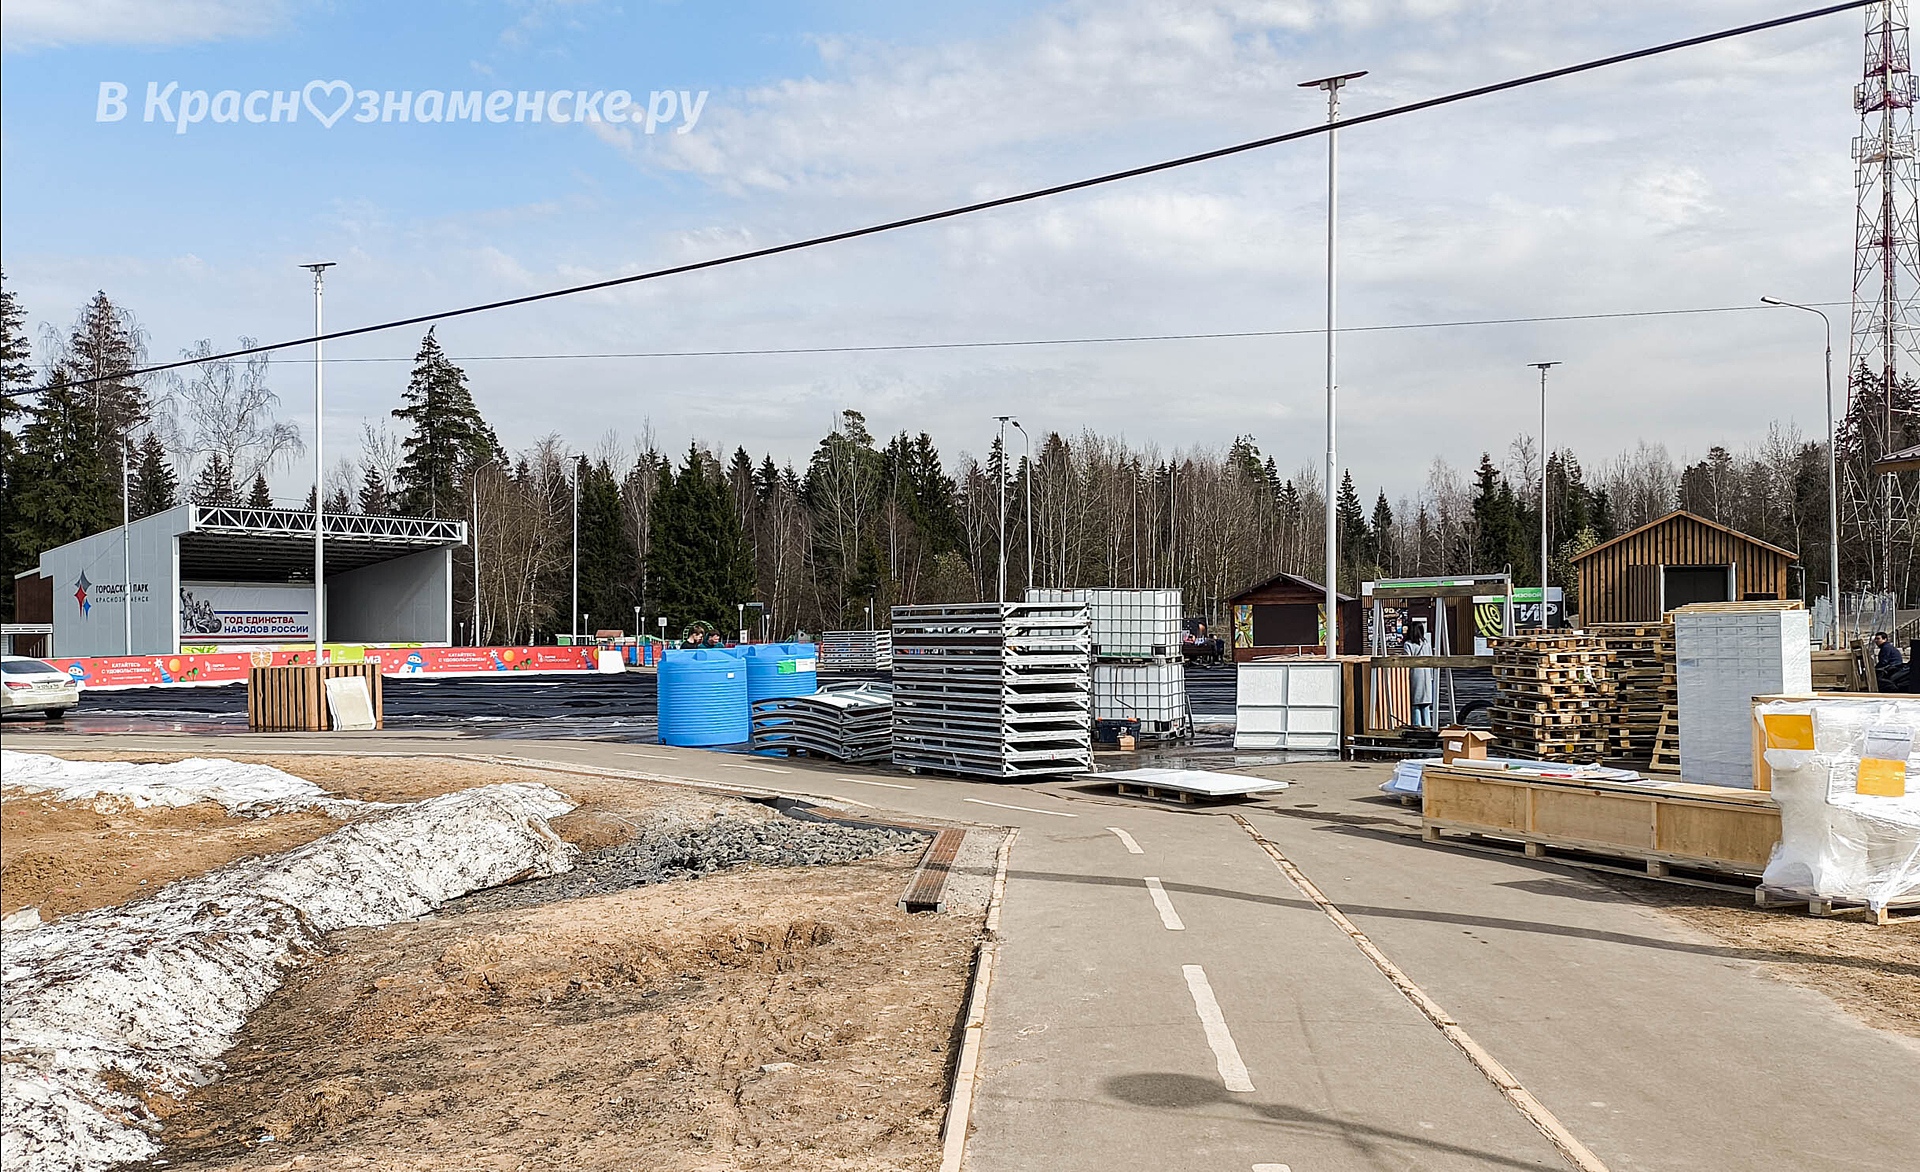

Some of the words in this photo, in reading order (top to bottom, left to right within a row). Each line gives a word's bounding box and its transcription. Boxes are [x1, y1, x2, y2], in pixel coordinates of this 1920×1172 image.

[133, 583, 149, 592] ПАРК
[224, 616, 243, 624] ГОД
[246, 616, 295, 624] ЕДИНСТВА
[224, 626, 269, 634] НАРОДОВ
